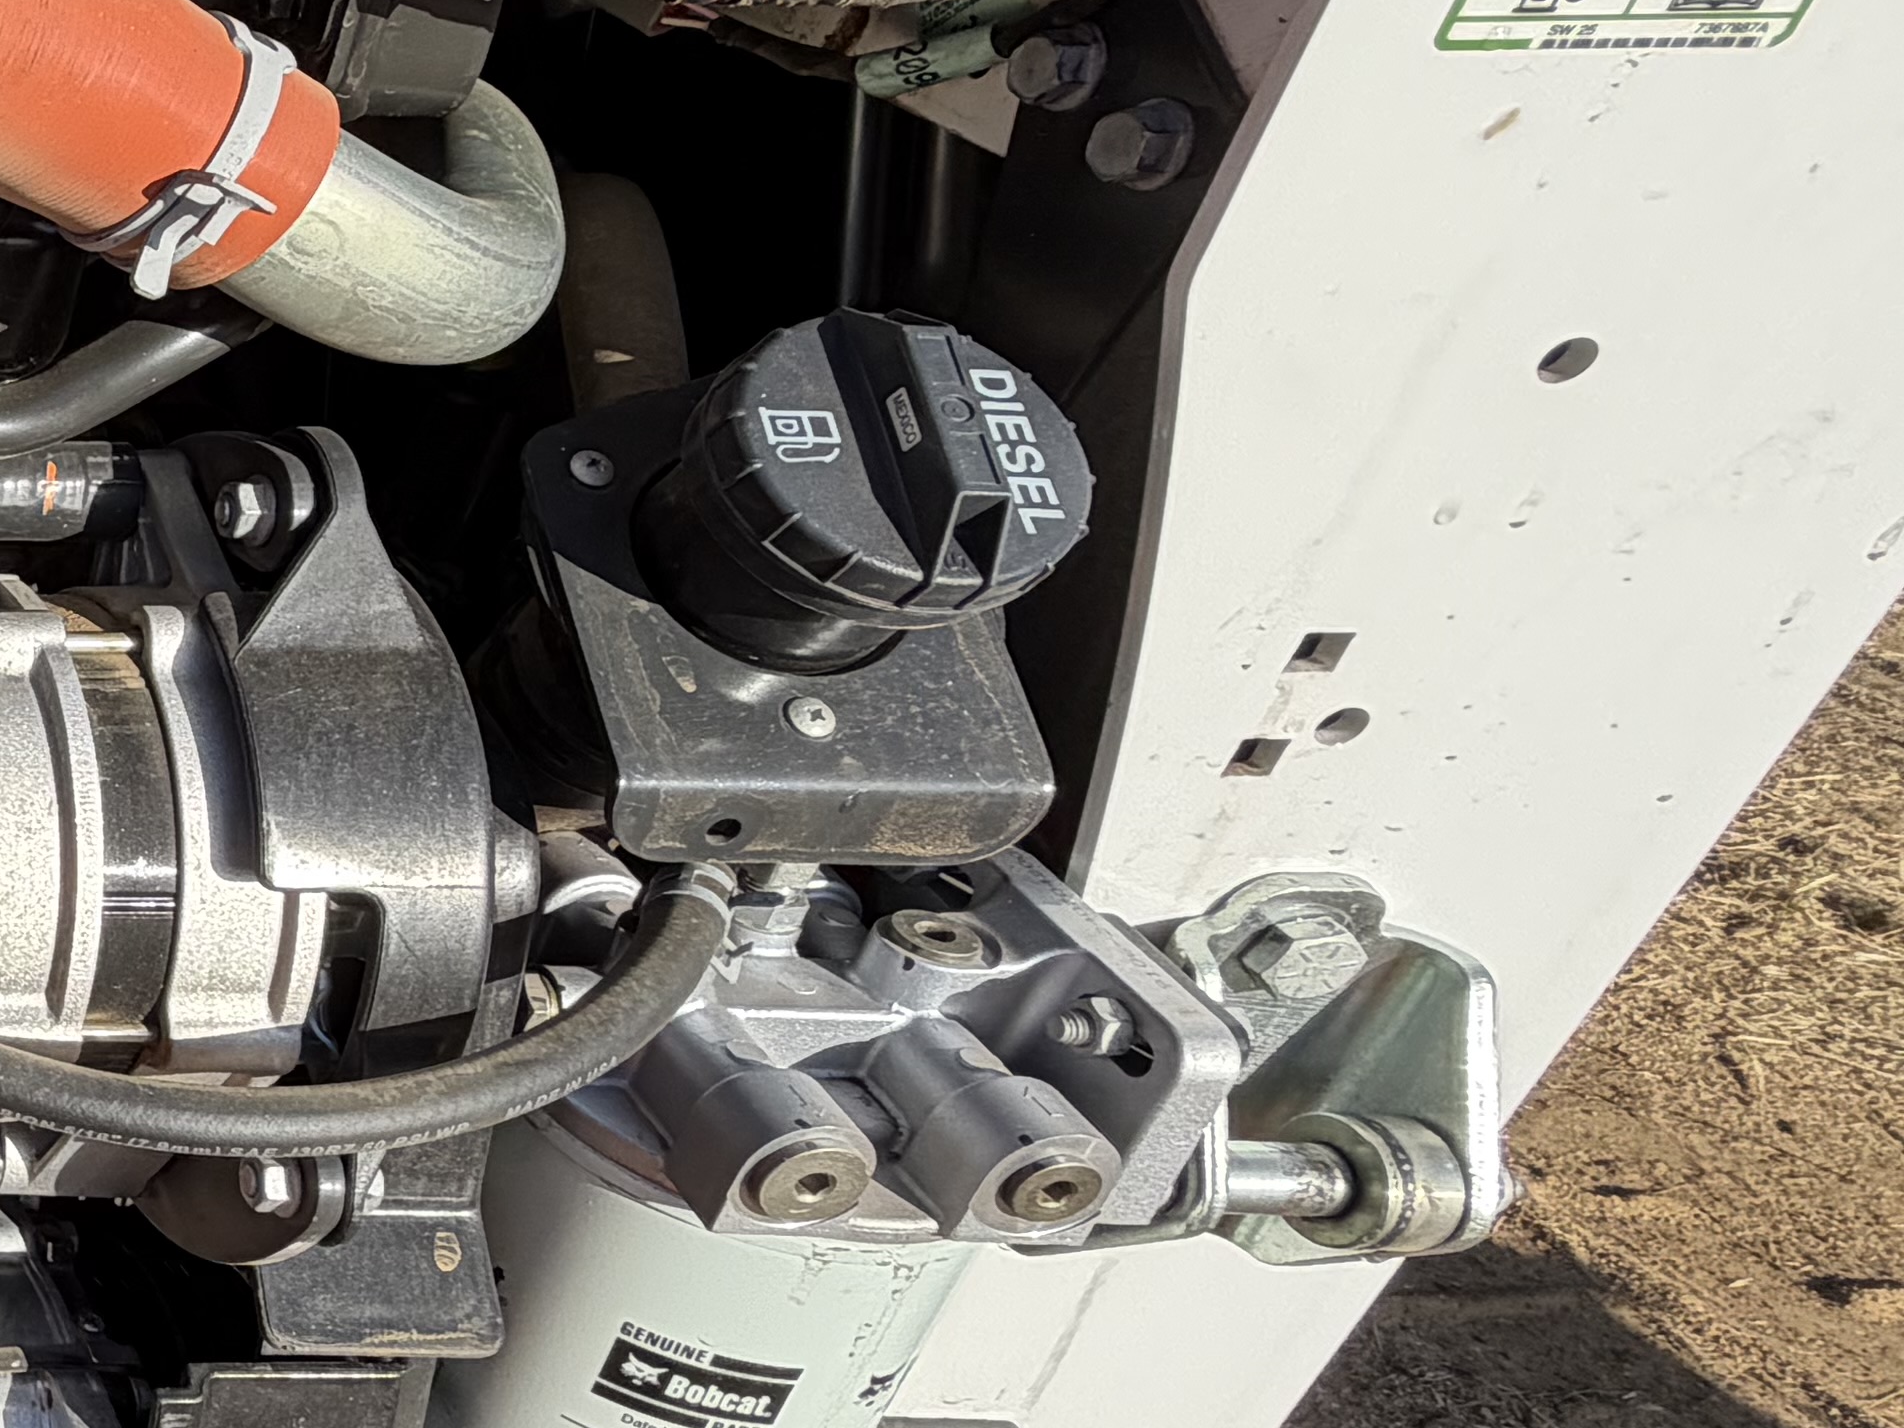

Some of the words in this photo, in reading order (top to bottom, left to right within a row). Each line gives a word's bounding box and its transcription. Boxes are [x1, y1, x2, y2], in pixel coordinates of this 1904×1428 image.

[893, 393, 918, 445] MEXICO
[968, 367, 1066, 535] DIESEL
[504, 1087, 559, 1120] MADE
[562, 1074, 583, 1097] IN
[585, 1055, 619, 1086] USA
[230, 1147, 279, 1159] SAE
[618, 1320, 709, 1364] GENUINE
[664, 1374, 773, 1419] Bobcat
